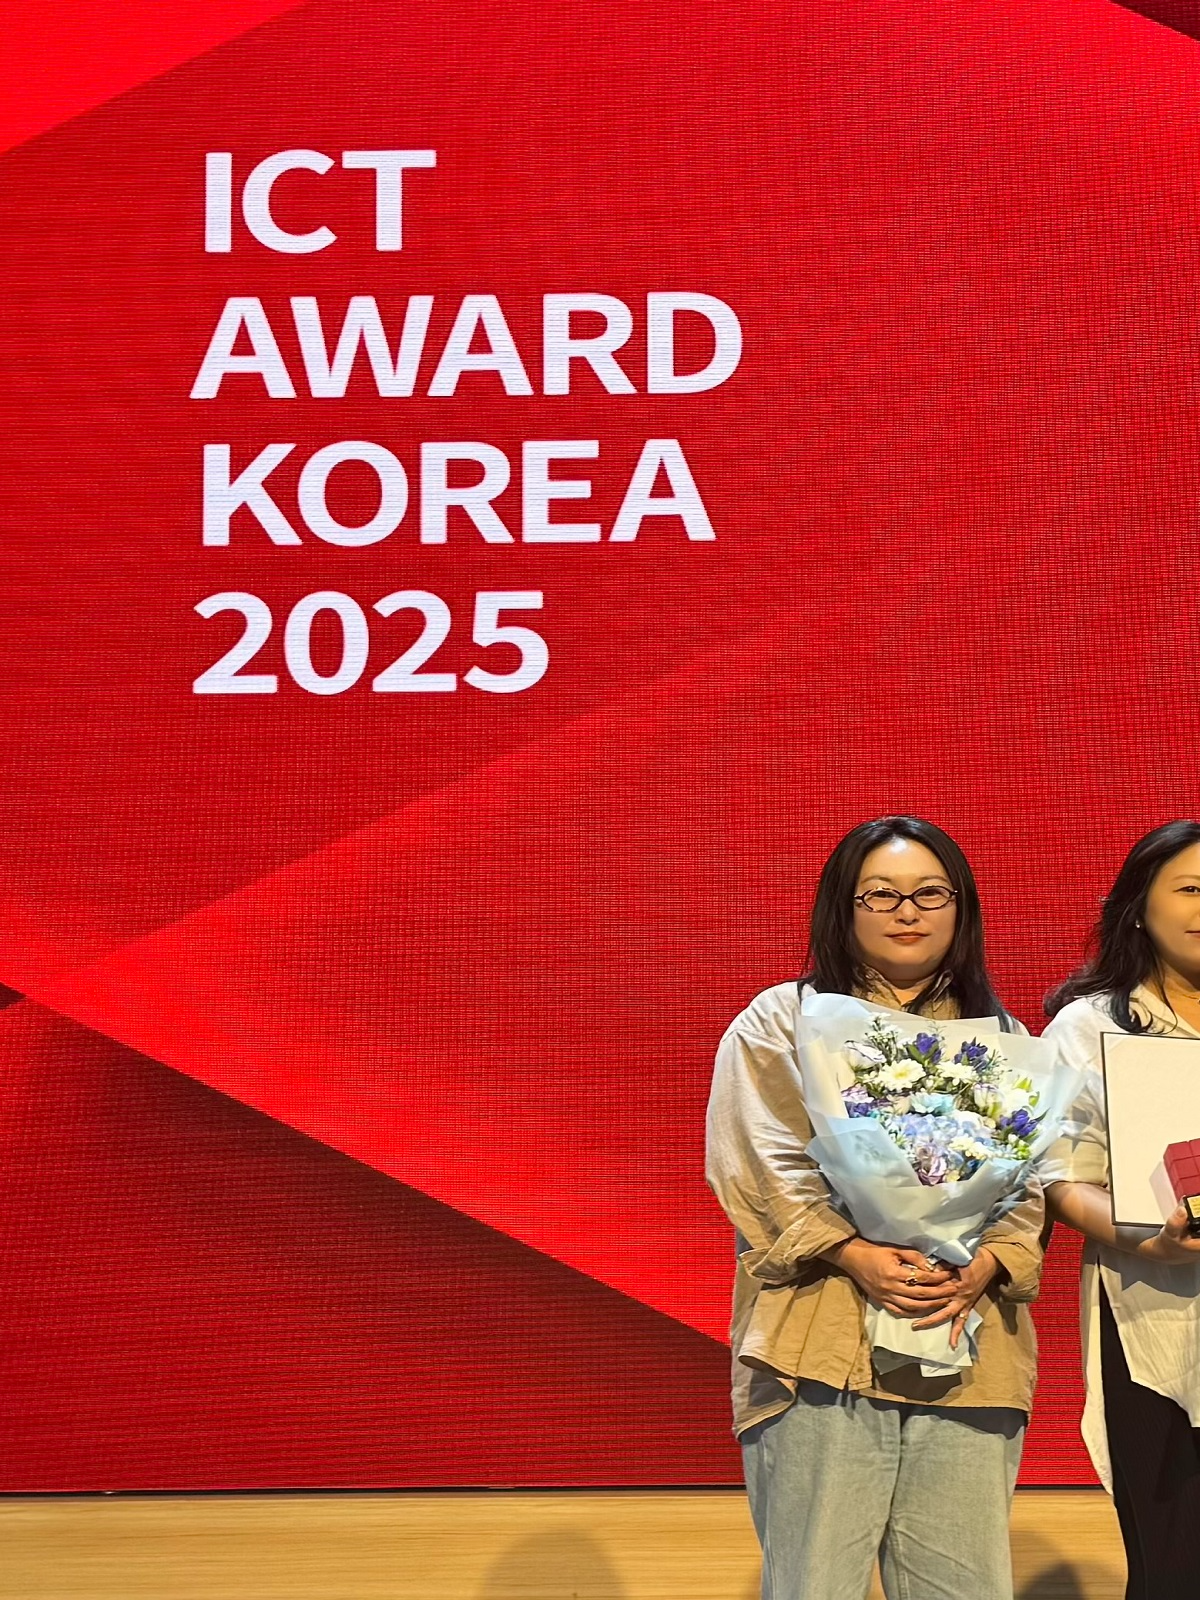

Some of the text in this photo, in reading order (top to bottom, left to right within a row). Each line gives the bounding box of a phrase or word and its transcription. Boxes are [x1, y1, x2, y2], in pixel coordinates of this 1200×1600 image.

[205, 150, 436, 253] ICT
[190, 292, 742, 398] AWARD
[203, 439, 715, 546] KOREA
[193, 591, 548, 695] 2025
